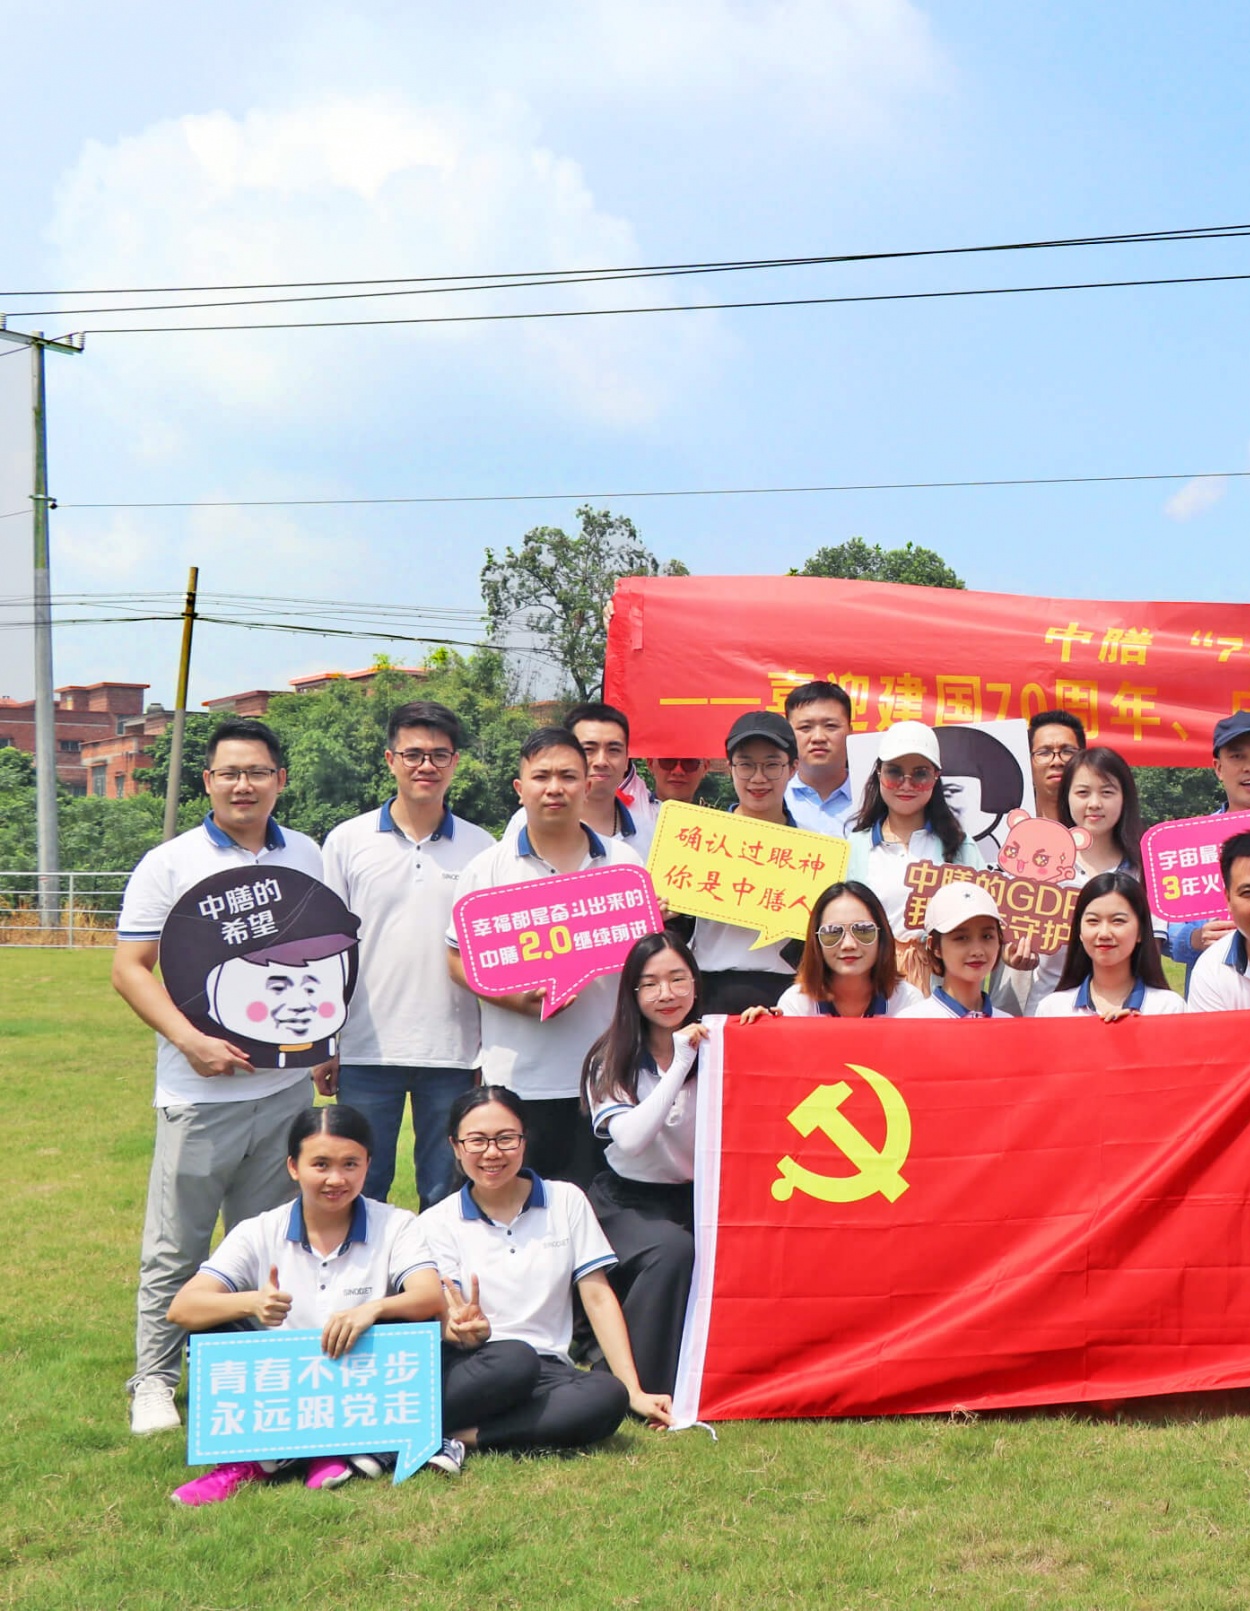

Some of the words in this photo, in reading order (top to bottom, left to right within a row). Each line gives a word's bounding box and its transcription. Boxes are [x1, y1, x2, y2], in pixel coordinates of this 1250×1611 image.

[674, 826, 826, 881] 确认过眼神
[198, 878, 282, 920] 中膳的
[471, 889, 644, 937] 幸福都是奋斗出来的
[663, 864, 813, 916] 你是中膳人
[221, 910, 279, 945] 希望
[209, 1350, 421, 1396] 青春不停步
[209, 1390, 421, 1436] 永远跟党走
